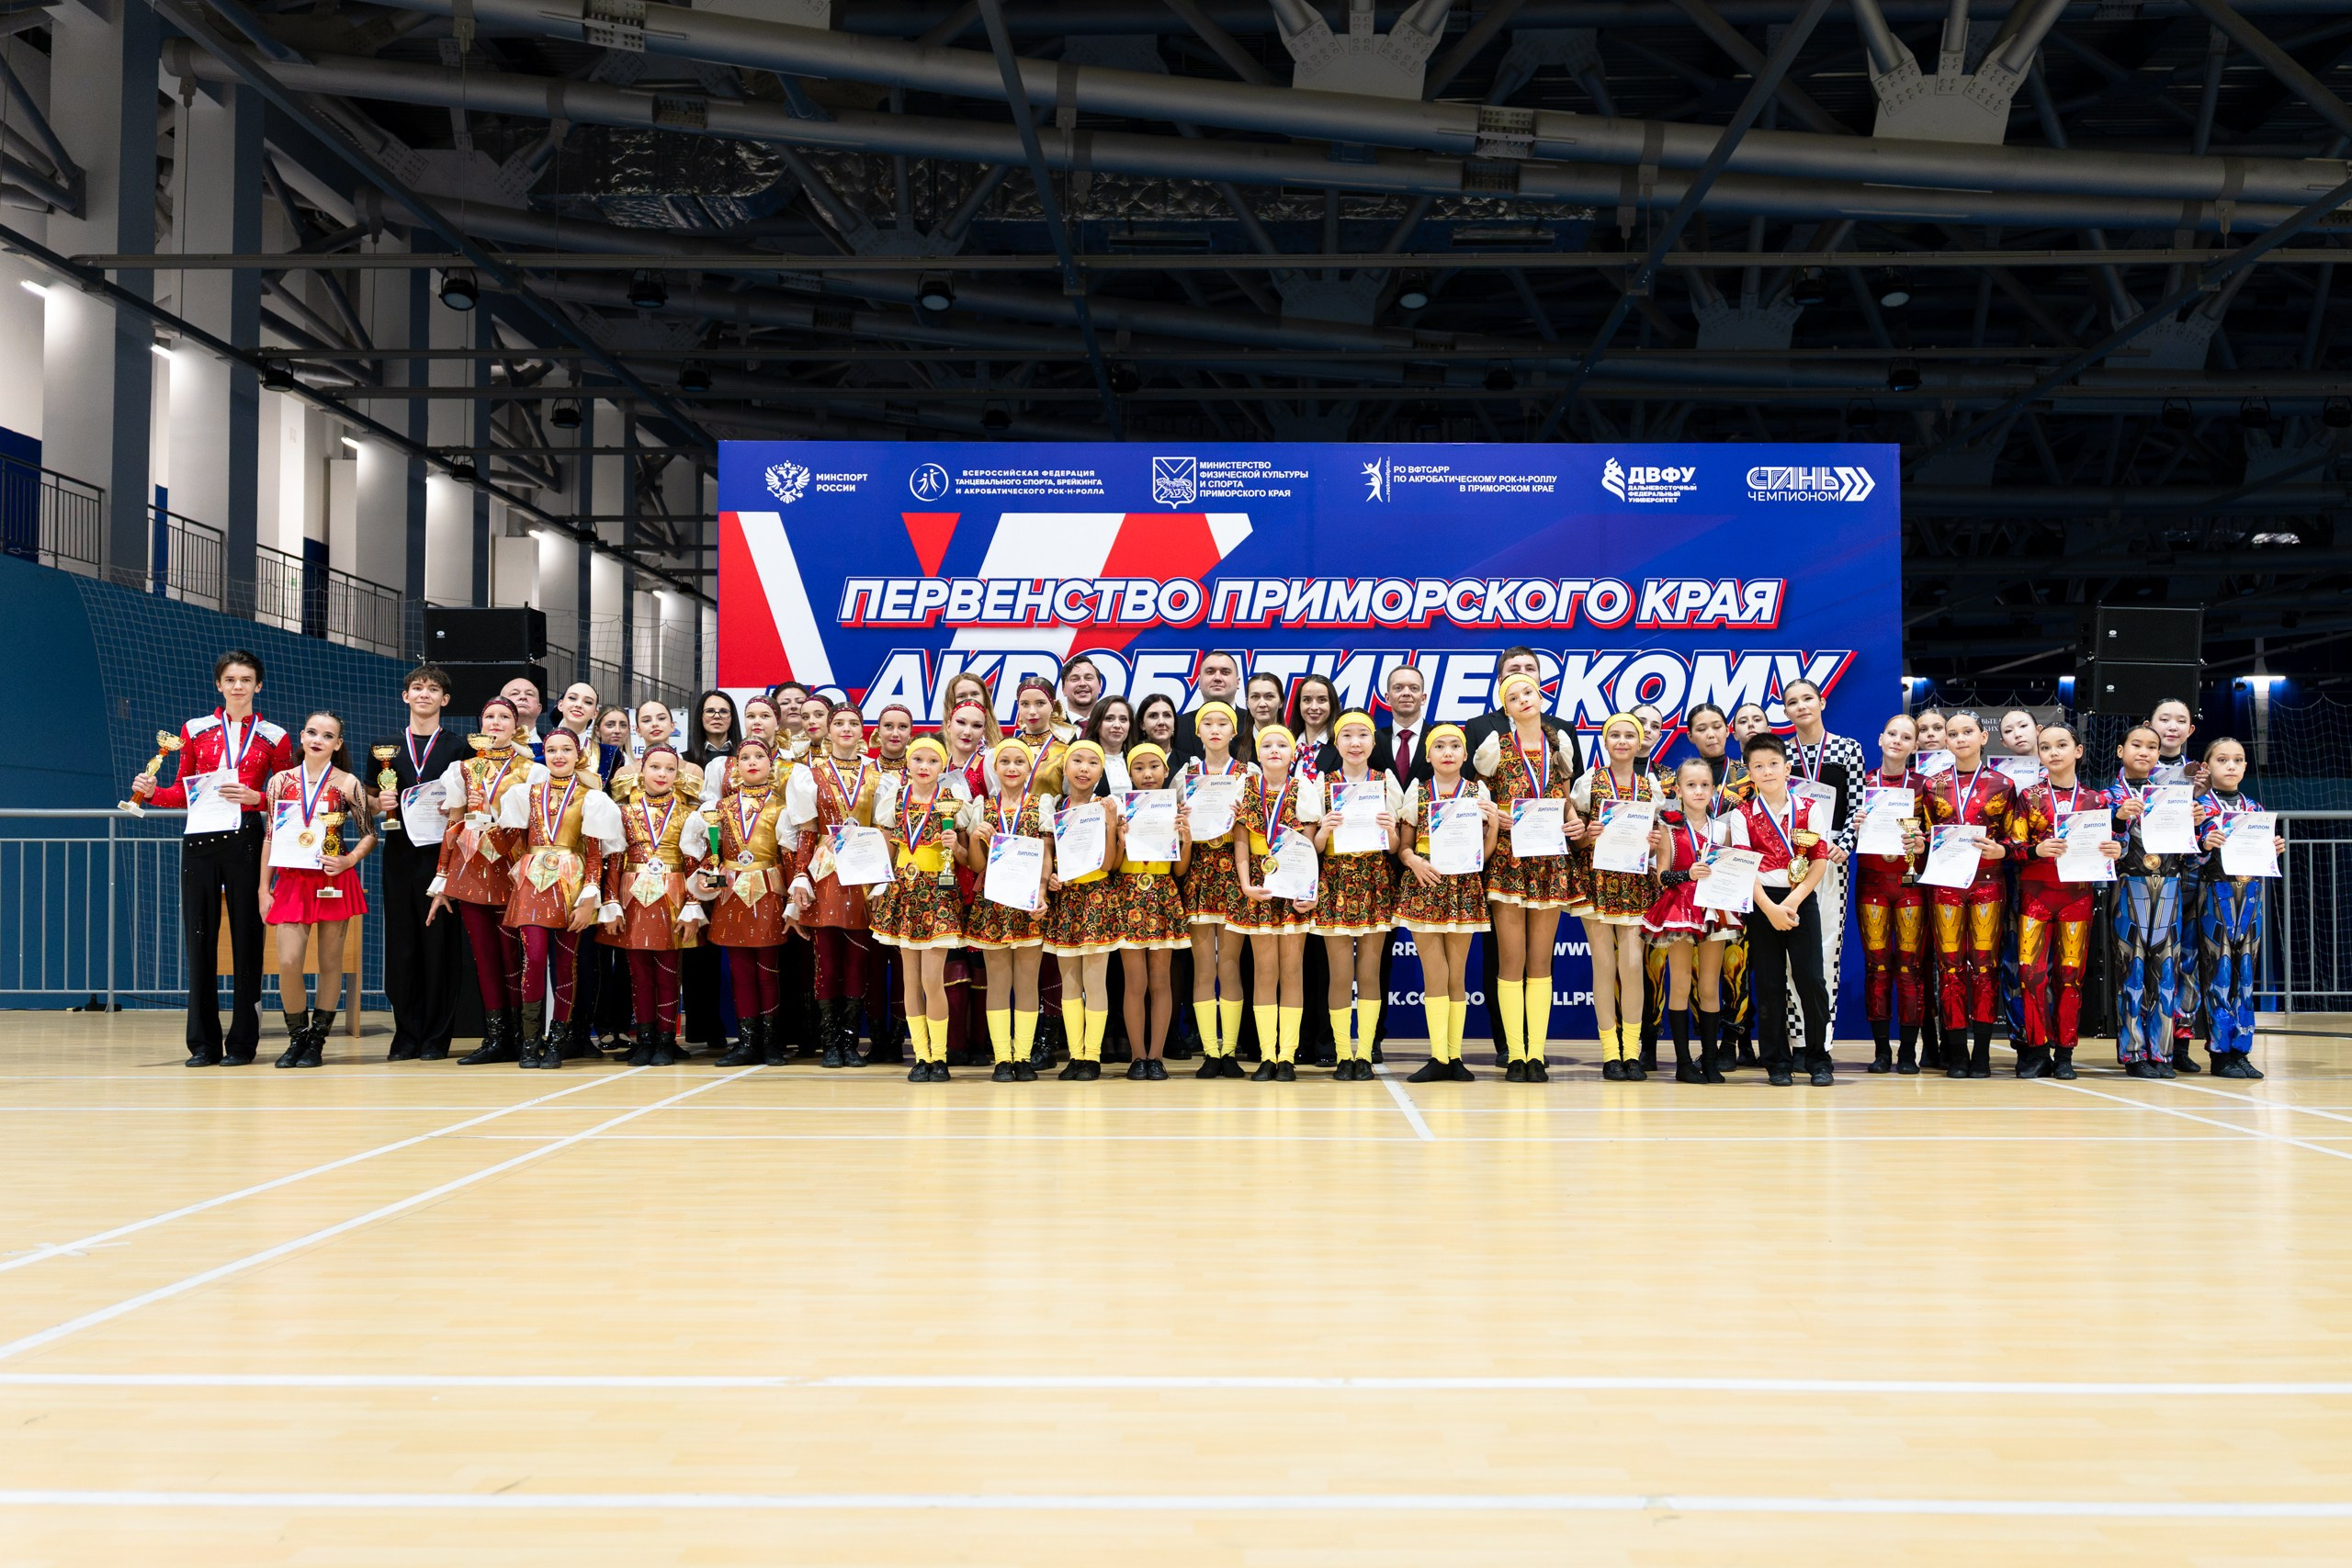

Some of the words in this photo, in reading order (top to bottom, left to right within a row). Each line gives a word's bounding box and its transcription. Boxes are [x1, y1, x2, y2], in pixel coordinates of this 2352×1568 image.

[1199, 461, 1272, 469] МИНИСТЕРСТВО
[816, 473, 868, 481] МИНСПОРТ
[1041, 469, 1095, 478] ФЕДЕРАЦИЯ
[1199, 470, 1261, 479] ФИЗИЧЕСКОЙ
[1261, 470, 1309, 479] КУЛЬТУРЫ
[1628, 467, 1696, 484] ДВФУ
[1023, 479, 1055, 487] СПОРТА,
[1057, 478, 1102, 486] БРЕЙКИНГА
[1393, 475, 1407, 483] ПО
[1408, 475, 1497, 483] АКРОБАТИЧЕСКОМУ
[1498, 475, 1557, 483] РОК-Н-РОЛЛУ
[1747, 467, 1839, 490] СТАНЬ
[816, 484, 856, 492] РОССИИ
[1199, 479, 1206, 488] И
[1208, 479, 1244, 488] СПОРТА
[1459, 484, 1466, 492] В
[1467, 484, 1531, 492] ПРИМОРСКОМ
[1532, 484, 1555, 492] КРАЕ
[1628, 483, 1697, 491] ДАЛЬНЕВОСТОЧНЫЙ
[1199, 489, 1266, 498] ПРИМОРСКОГО
[1268, 490, 1291, 498] КРАЯ
[1747, 491, 1839, 502] ЧЕМПИОНОМ
[837, 576, 1207, 626] ПЕРВЕНСТВО
[1207, 576, 1635, 626] ПРИМОРСКОГО
[1634, 577, 1785, 627] КРАЯ
[1732, 856, 1755, 865] ДИПЛОМ
